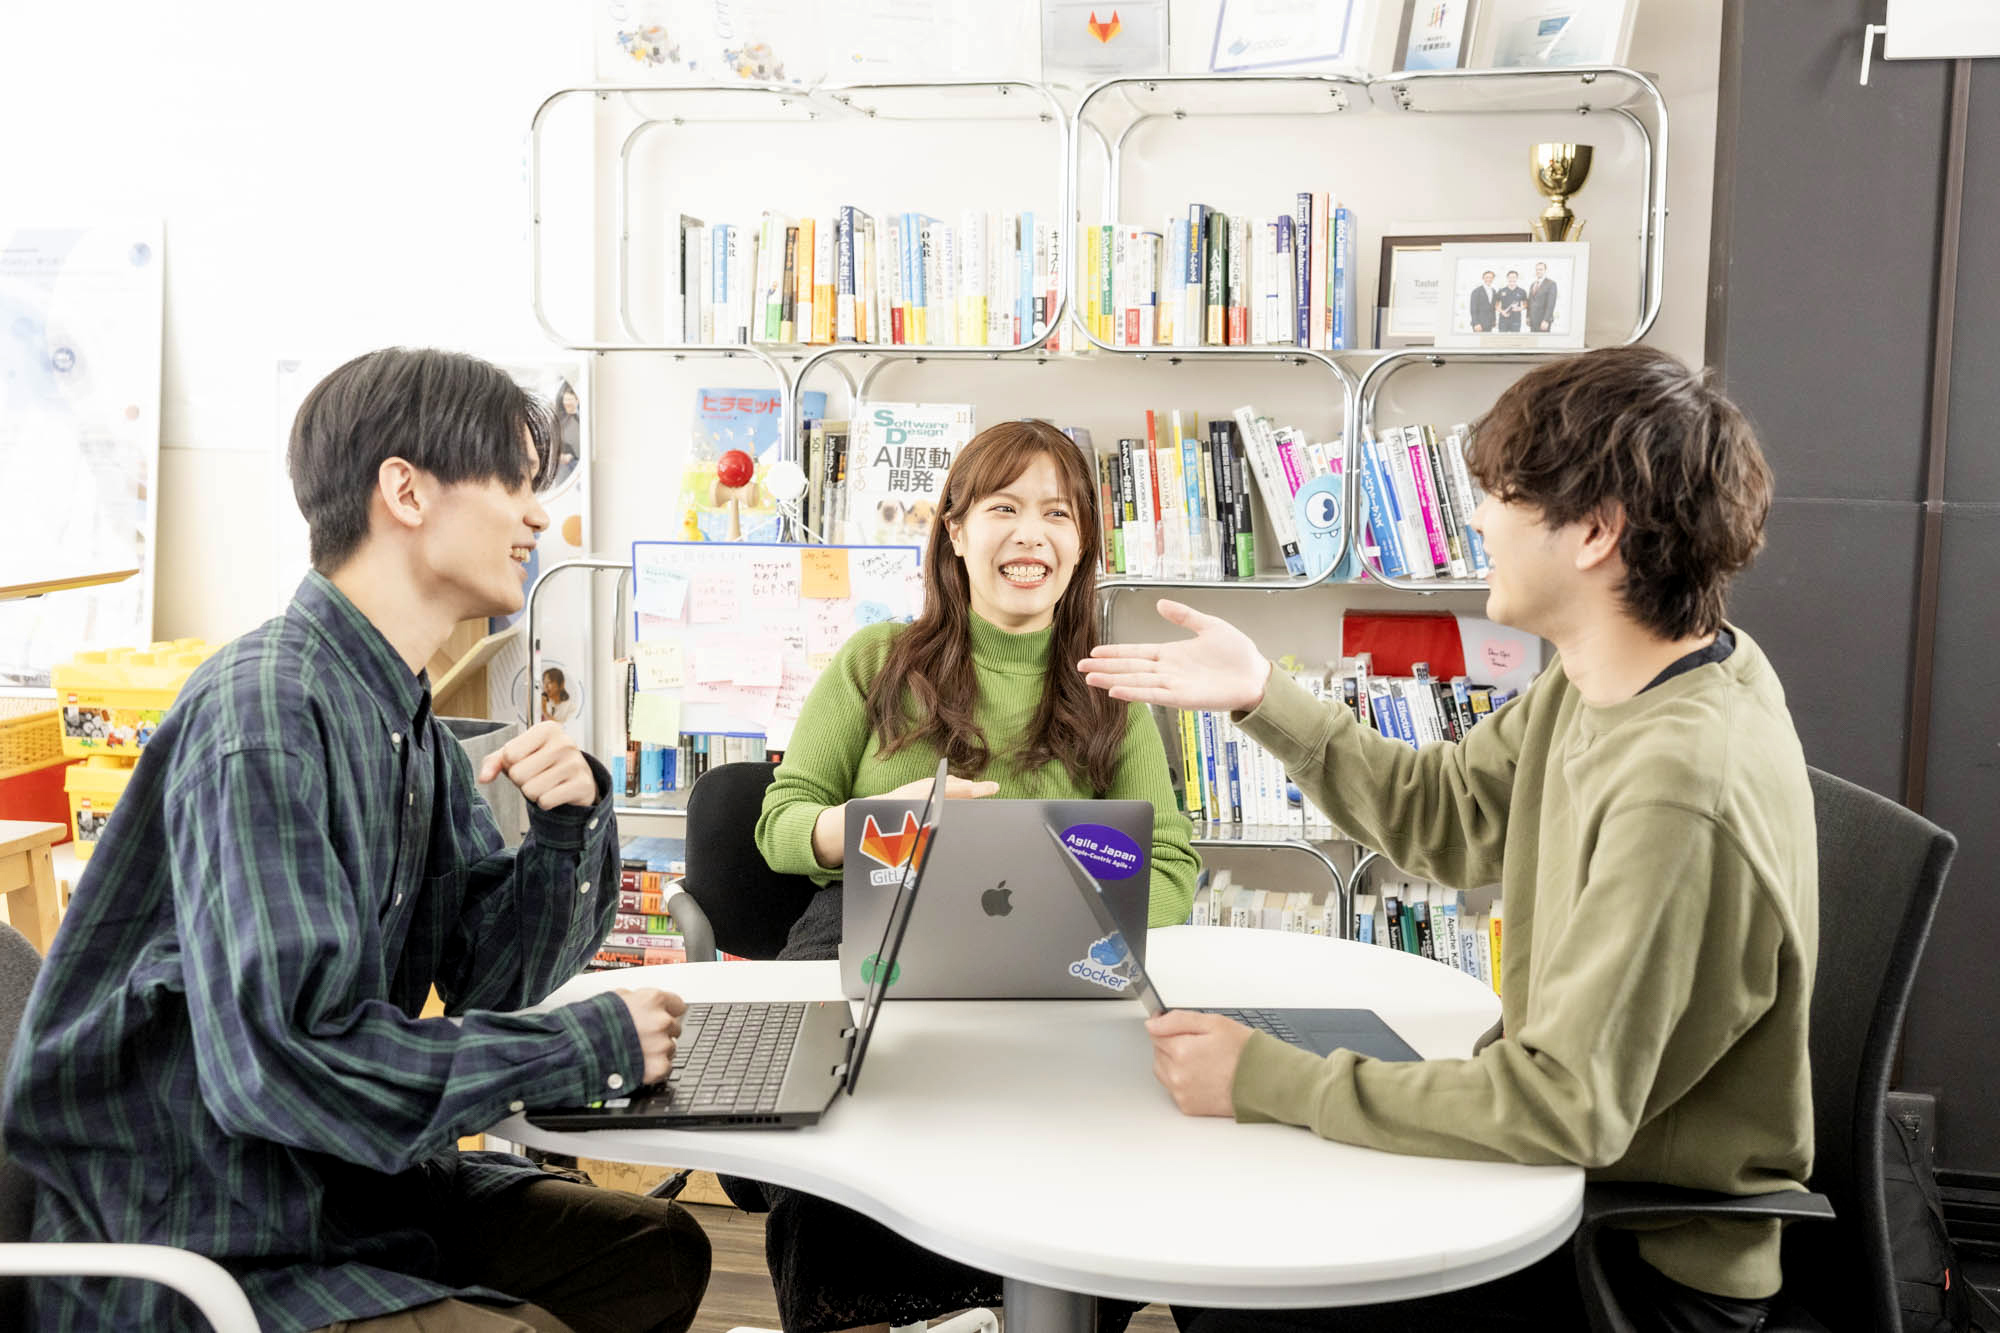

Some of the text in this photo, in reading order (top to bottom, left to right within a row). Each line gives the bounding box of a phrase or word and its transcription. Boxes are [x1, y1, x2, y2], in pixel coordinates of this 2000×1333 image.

[873, 409, 949, 428] Software
[885, 427, 944, 445] Design
[872, 446, 951, 470] AI駆動
[888, 470, 934, 493] 開発
[1067, 834, 1136, 862] Agile Japan
[872, 869, 908, 885] GitL
[1432, 905, 1444, 941] Flask
[1448, 917, 1456, 950] Apache
[1071, 962, 1127, 988] docker
